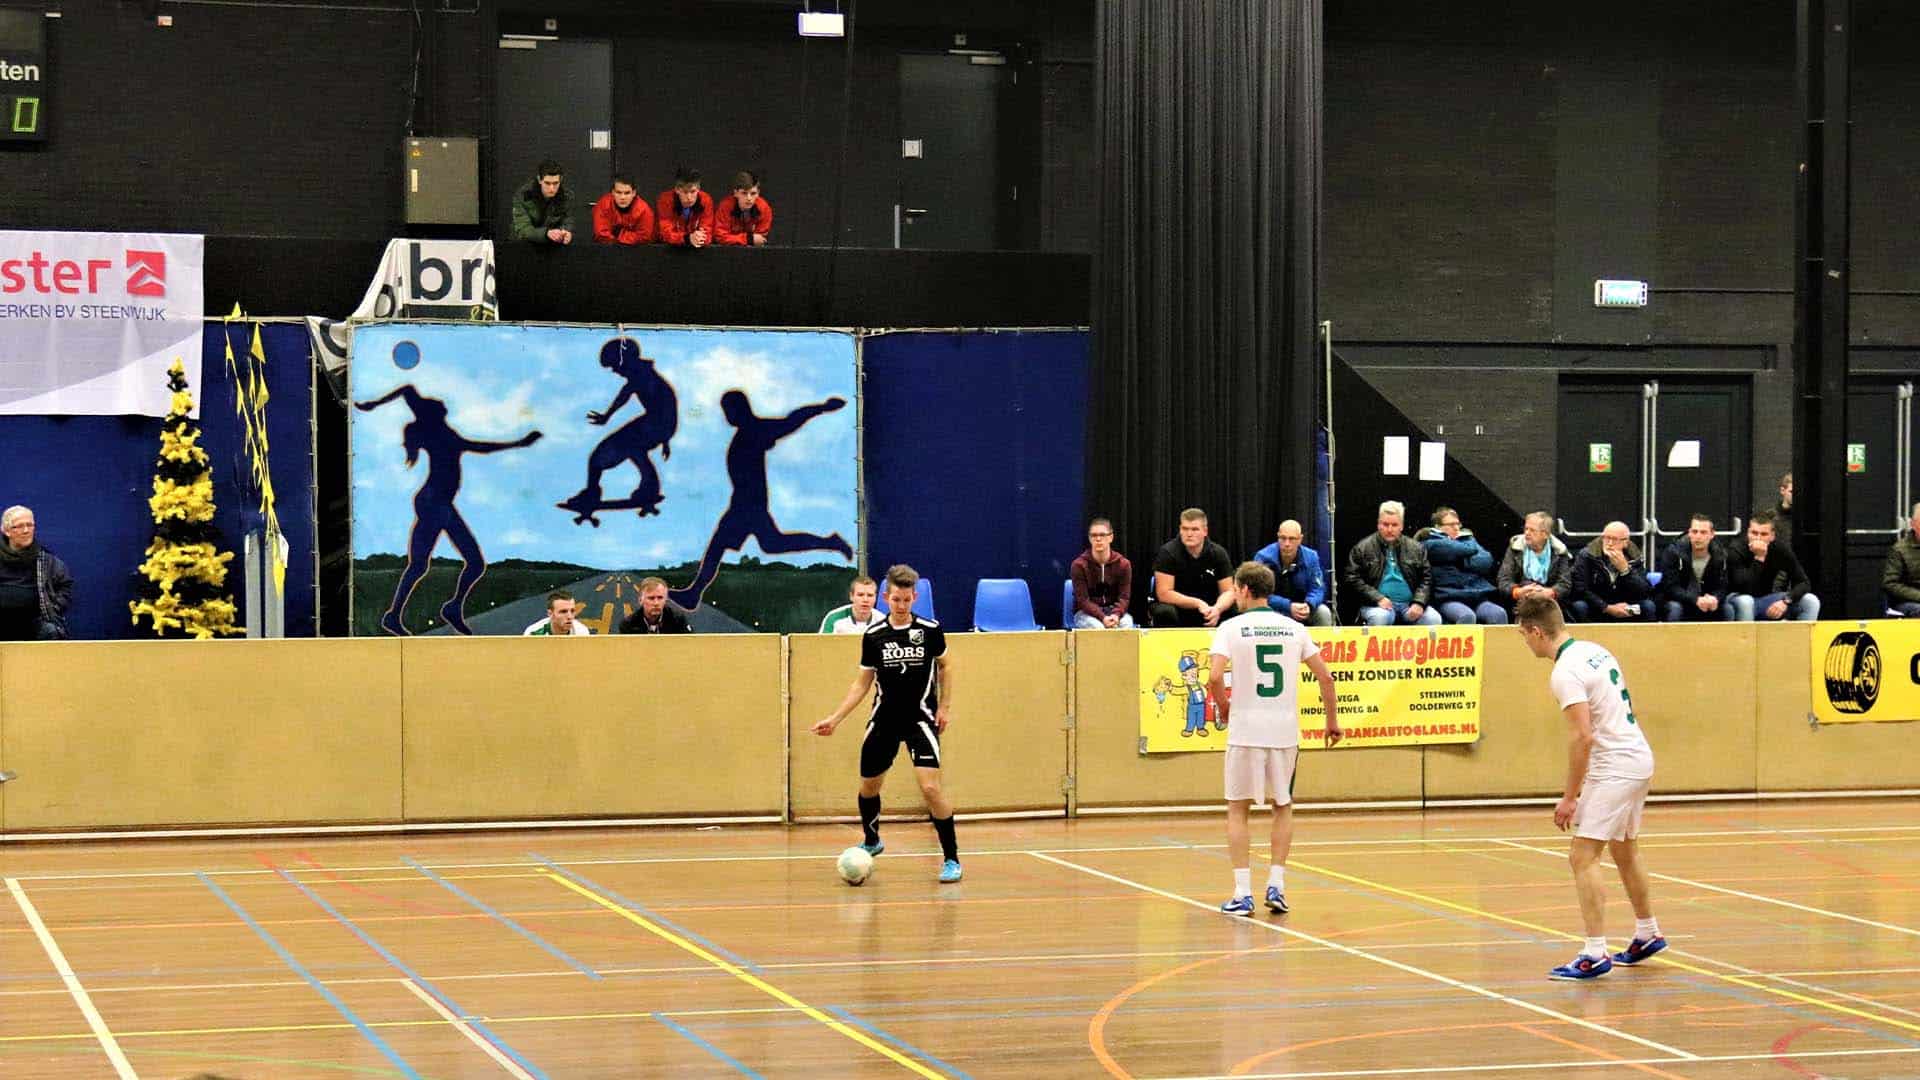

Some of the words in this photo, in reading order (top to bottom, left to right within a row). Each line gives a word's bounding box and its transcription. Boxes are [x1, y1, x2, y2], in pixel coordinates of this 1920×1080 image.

[0, 60, 40, 81] ten
[13, 97, 39, 132] 0
[0, 251, 112, 294] ster
[55, 304, 76, 319] BV
[81, 304, 165, 321] STEENWIJK
[882, 646, 925, 660] KORS
[1364, 635, 1475, 666] Autoglans
[1255, 644, 1284, 698] 5
[1301, 670, 1354, 683] WSEN
[1358, 668, 1412, 681] ZONDER
[1416, 665, 1476, 679] KRASSEN
[1419, 690, 1466, 699] STEENWIJK
